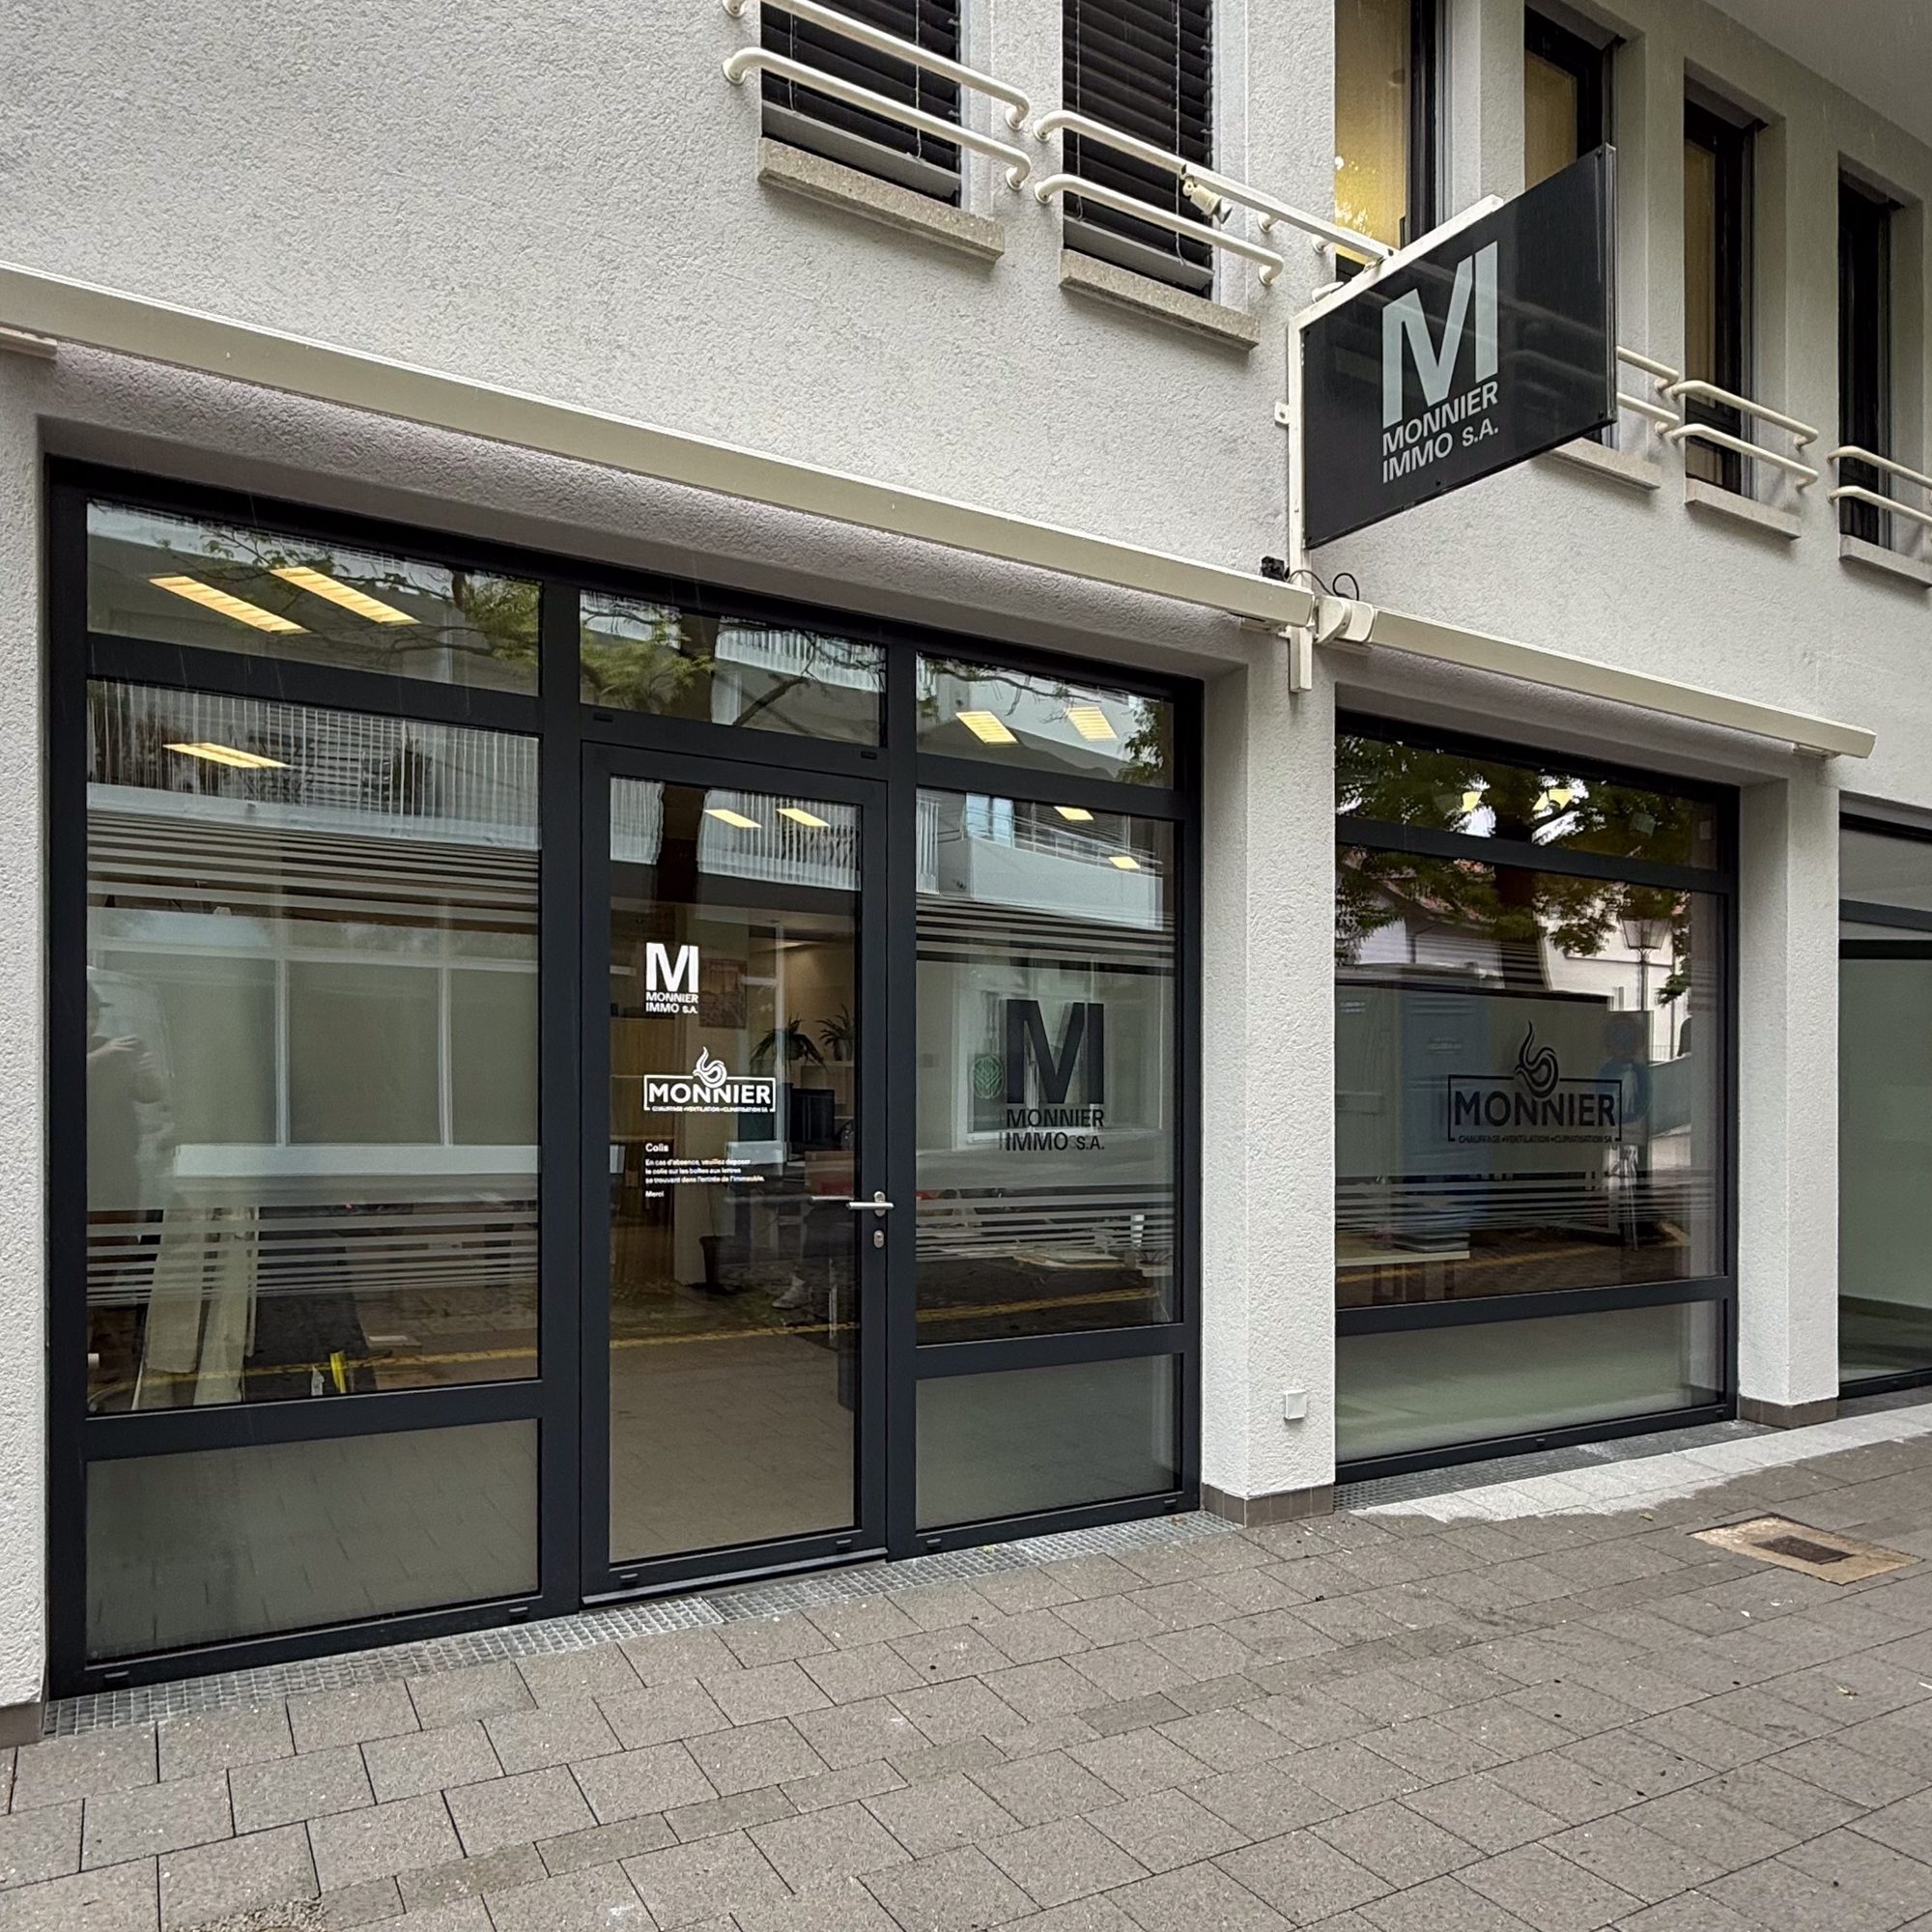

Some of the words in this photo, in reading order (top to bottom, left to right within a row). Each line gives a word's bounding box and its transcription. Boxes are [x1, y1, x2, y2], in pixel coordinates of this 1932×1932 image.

[1382, 241, 1498, 429] M
[1382, 381, 1498, 457] MONNIER
[1382, 432, 1453, 484] IMMO
[1462, 417, 1499, 447] S.A.
[645, 942, 699, 993] M
[645, 991, 699, 1004] MONNIER
[645, 1002, 680, 1013] IMMO
[682, 1005, 699, 1014] S.A.
[1007, 1000, 1104, 1104] M
[648, 1082, 771, 1104] MONNIER
[1007, 1108, 1104, 1127] MONNIER
[1454, 1090, 1616, 1127] MONNIER
[645, 1143, 668, 1152] Colis
[1007, 1131, 1068, 1151] IMMO
[1076, 1135, 1105, 1151] S.A.
